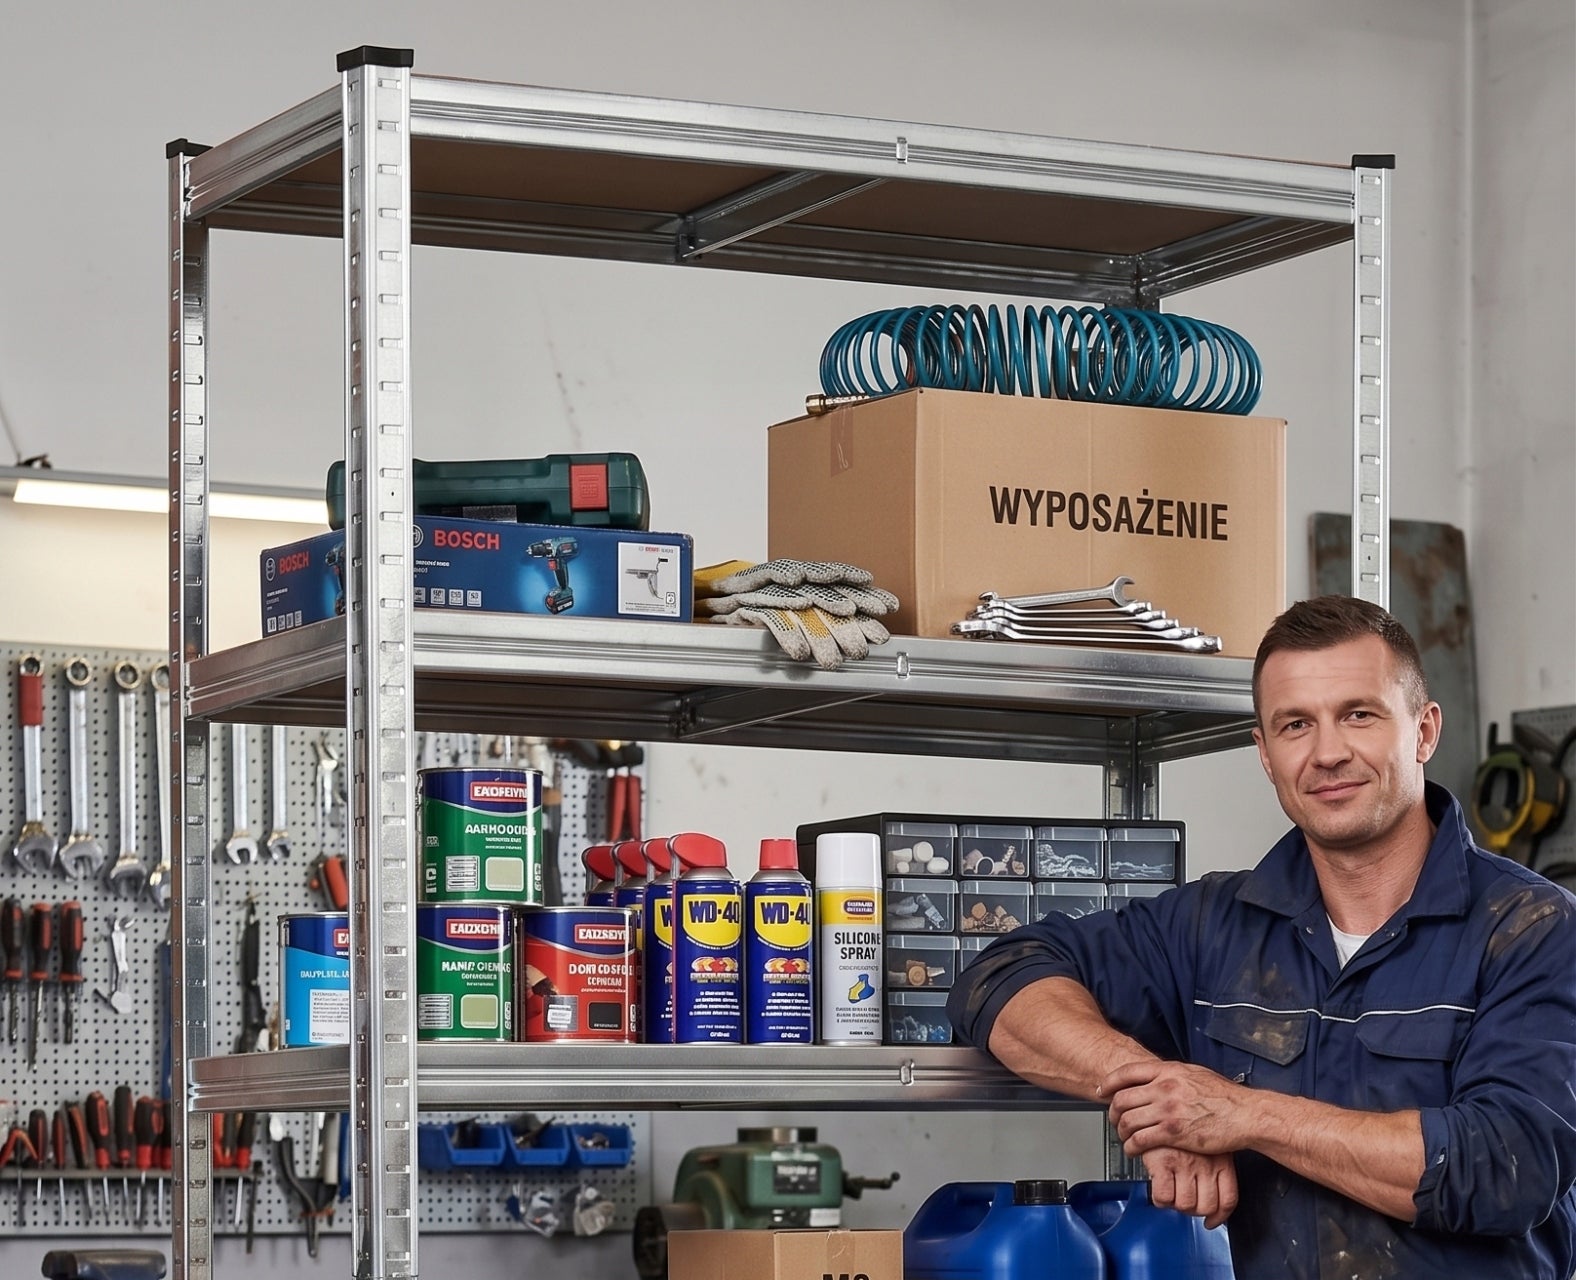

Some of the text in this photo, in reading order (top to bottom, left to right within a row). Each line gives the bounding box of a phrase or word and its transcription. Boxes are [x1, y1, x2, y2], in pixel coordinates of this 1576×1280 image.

[989, 485, 1228, 541] WYPOSAŻENIE
[434, 529, 500, 551] BOSCH
[278, 551, 310, 575] BOSCH
[840, 946, 877, 961] SPRAY
